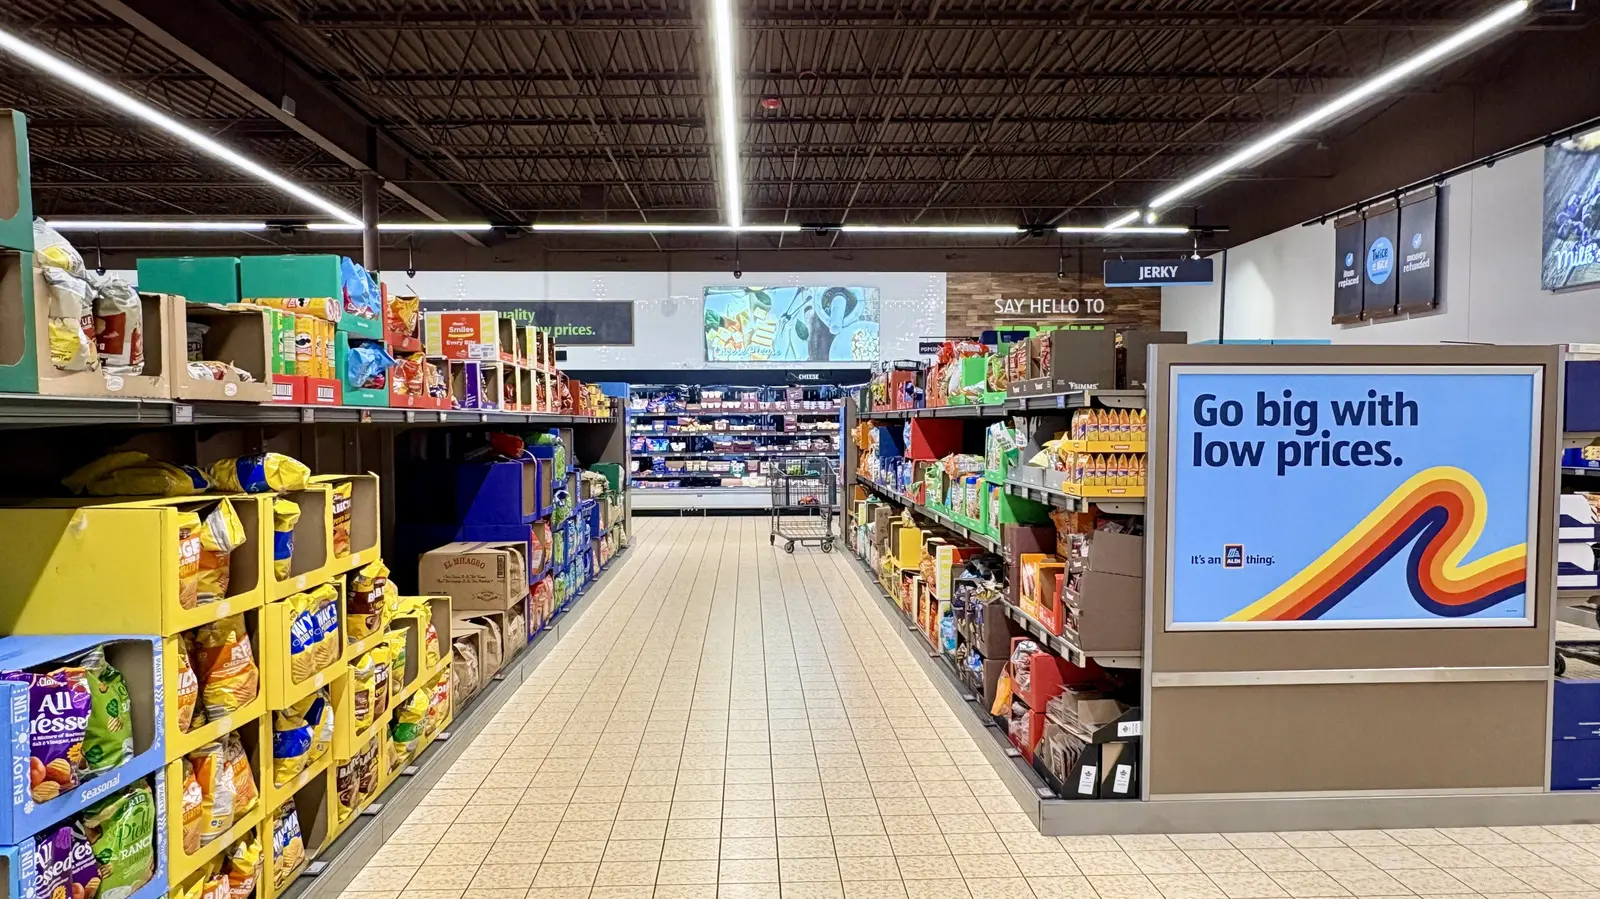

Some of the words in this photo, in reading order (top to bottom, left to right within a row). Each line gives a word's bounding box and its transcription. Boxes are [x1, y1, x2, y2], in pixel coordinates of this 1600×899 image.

[1407, 251, 1426, 262] money
[1403, 258, 1430, 272] refunded
[1139, 266, 1178, 280] JERKY
[1343, 270, 1354, 278] item
[1338, 276, 1359, 288] replaced
[995, 299, 1024, 314] SAY
[1030, 299, 1079, 314] HELLO
[1084, 299, 1104, 314] TO
[500, 309, 535, 323] uality
[554, 323, 596, 337] prices.
[1194, 393, 1243, 427] Go
[1256, 389, 1318, 436] big
[1330, 389, 1418, 427] with
[1193, 432, 1265, 467] low
[1277, 429, 1403, 476] prices.
[444, 560, 453, 570] EL
[453, 557, 486, 569] MILAGRO
[1191, 554, 1206, 565] It's
[1208, 556, 1221, 565] an
[14, 694, 27, 723] FUN
[38, 691, 73, 715] All
[13, 756, 24, 806] ENJOY
[81, 773, 120, 803] Seasonal
[22, 849, 34, 880] FUN
